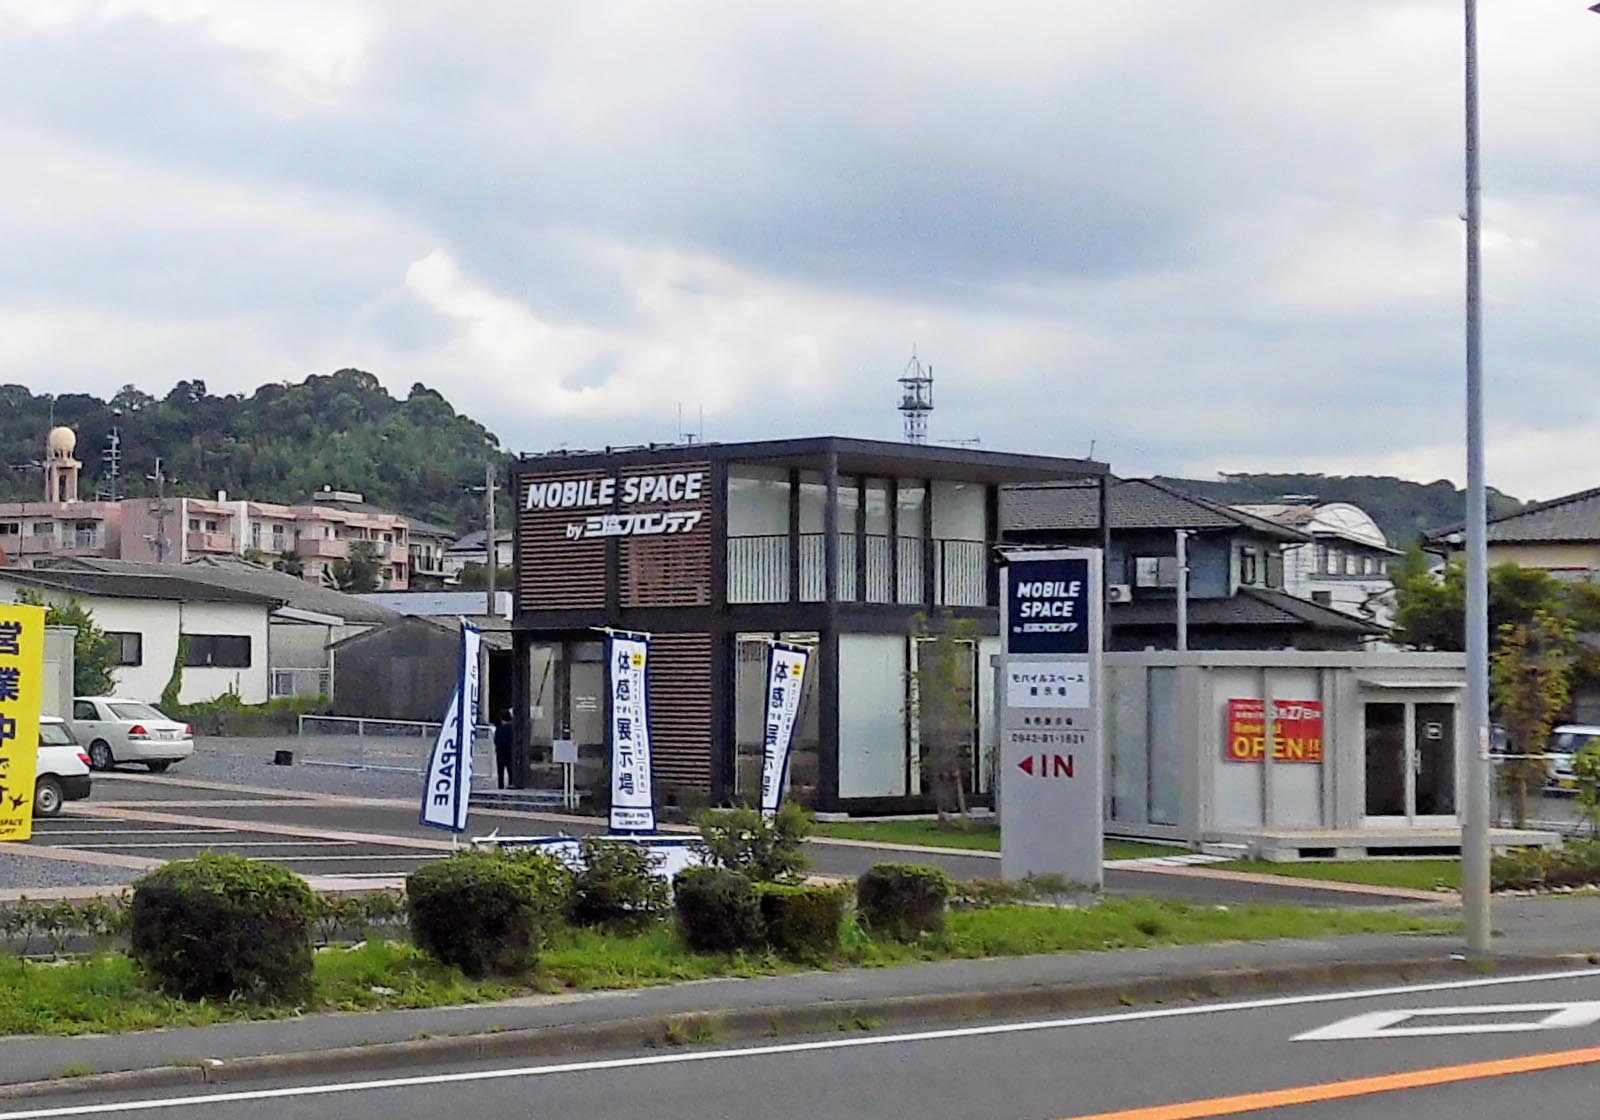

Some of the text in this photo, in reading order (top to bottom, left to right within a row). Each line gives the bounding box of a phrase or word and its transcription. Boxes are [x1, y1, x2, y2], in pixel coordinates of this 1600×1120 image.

[526, 473, 703, 510] MOBILE SPACE
[566, 523, 583, 540] by
[1016, 581, 1081, 598] MOBILE
[1020, 601, 1075, 618] SPACE
[1012, 674, 1084, 683] モバイルスペース
[1041, 754, 1074, 778] IN
